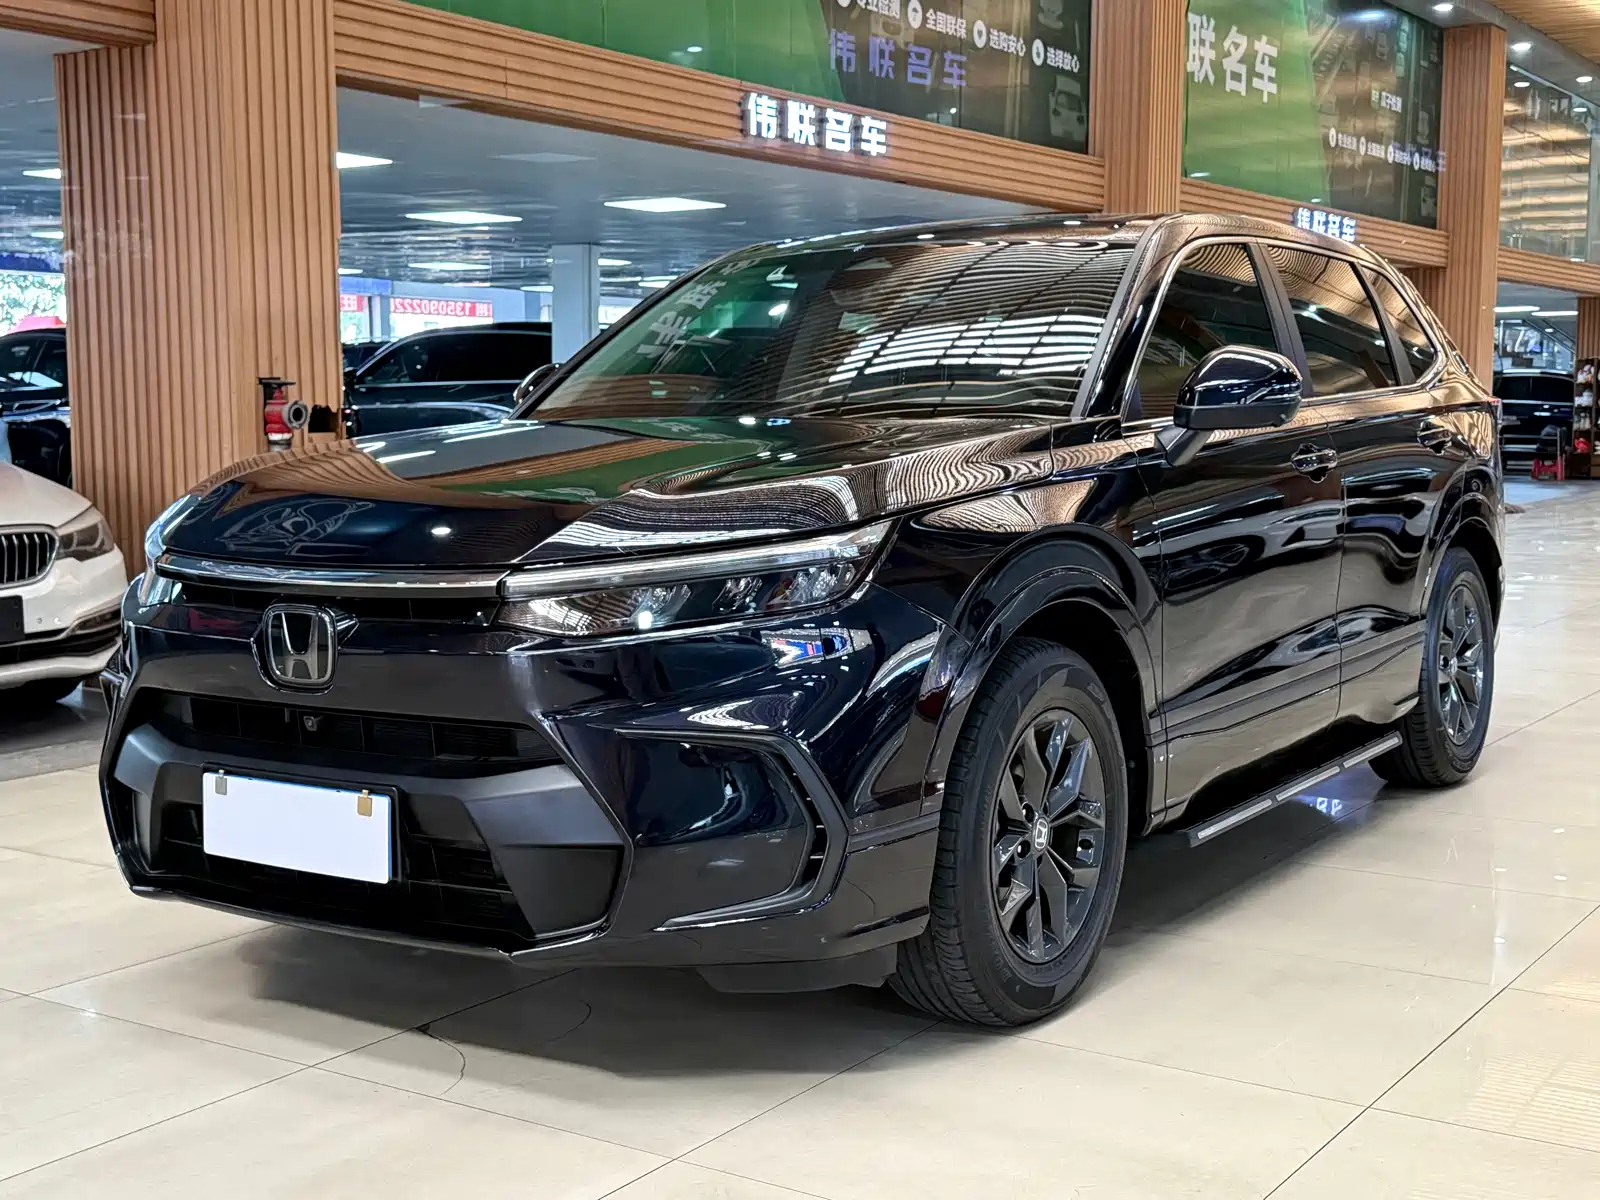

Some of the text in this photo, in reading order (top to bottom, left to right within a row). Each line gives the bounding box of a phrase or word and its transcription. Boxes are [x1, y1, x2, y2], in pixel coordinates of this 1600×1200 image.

[829, 28, 967, 88] 伟联名车
[925, 8, 967, 39] 全国联保
[989, 28, 1025, 57] 选购安心
[1046, 47, 1080, 73] 选择放心
[1186, 12, 1278, 104] 联名车
[748, 92, 887, 156] 伟联名车
